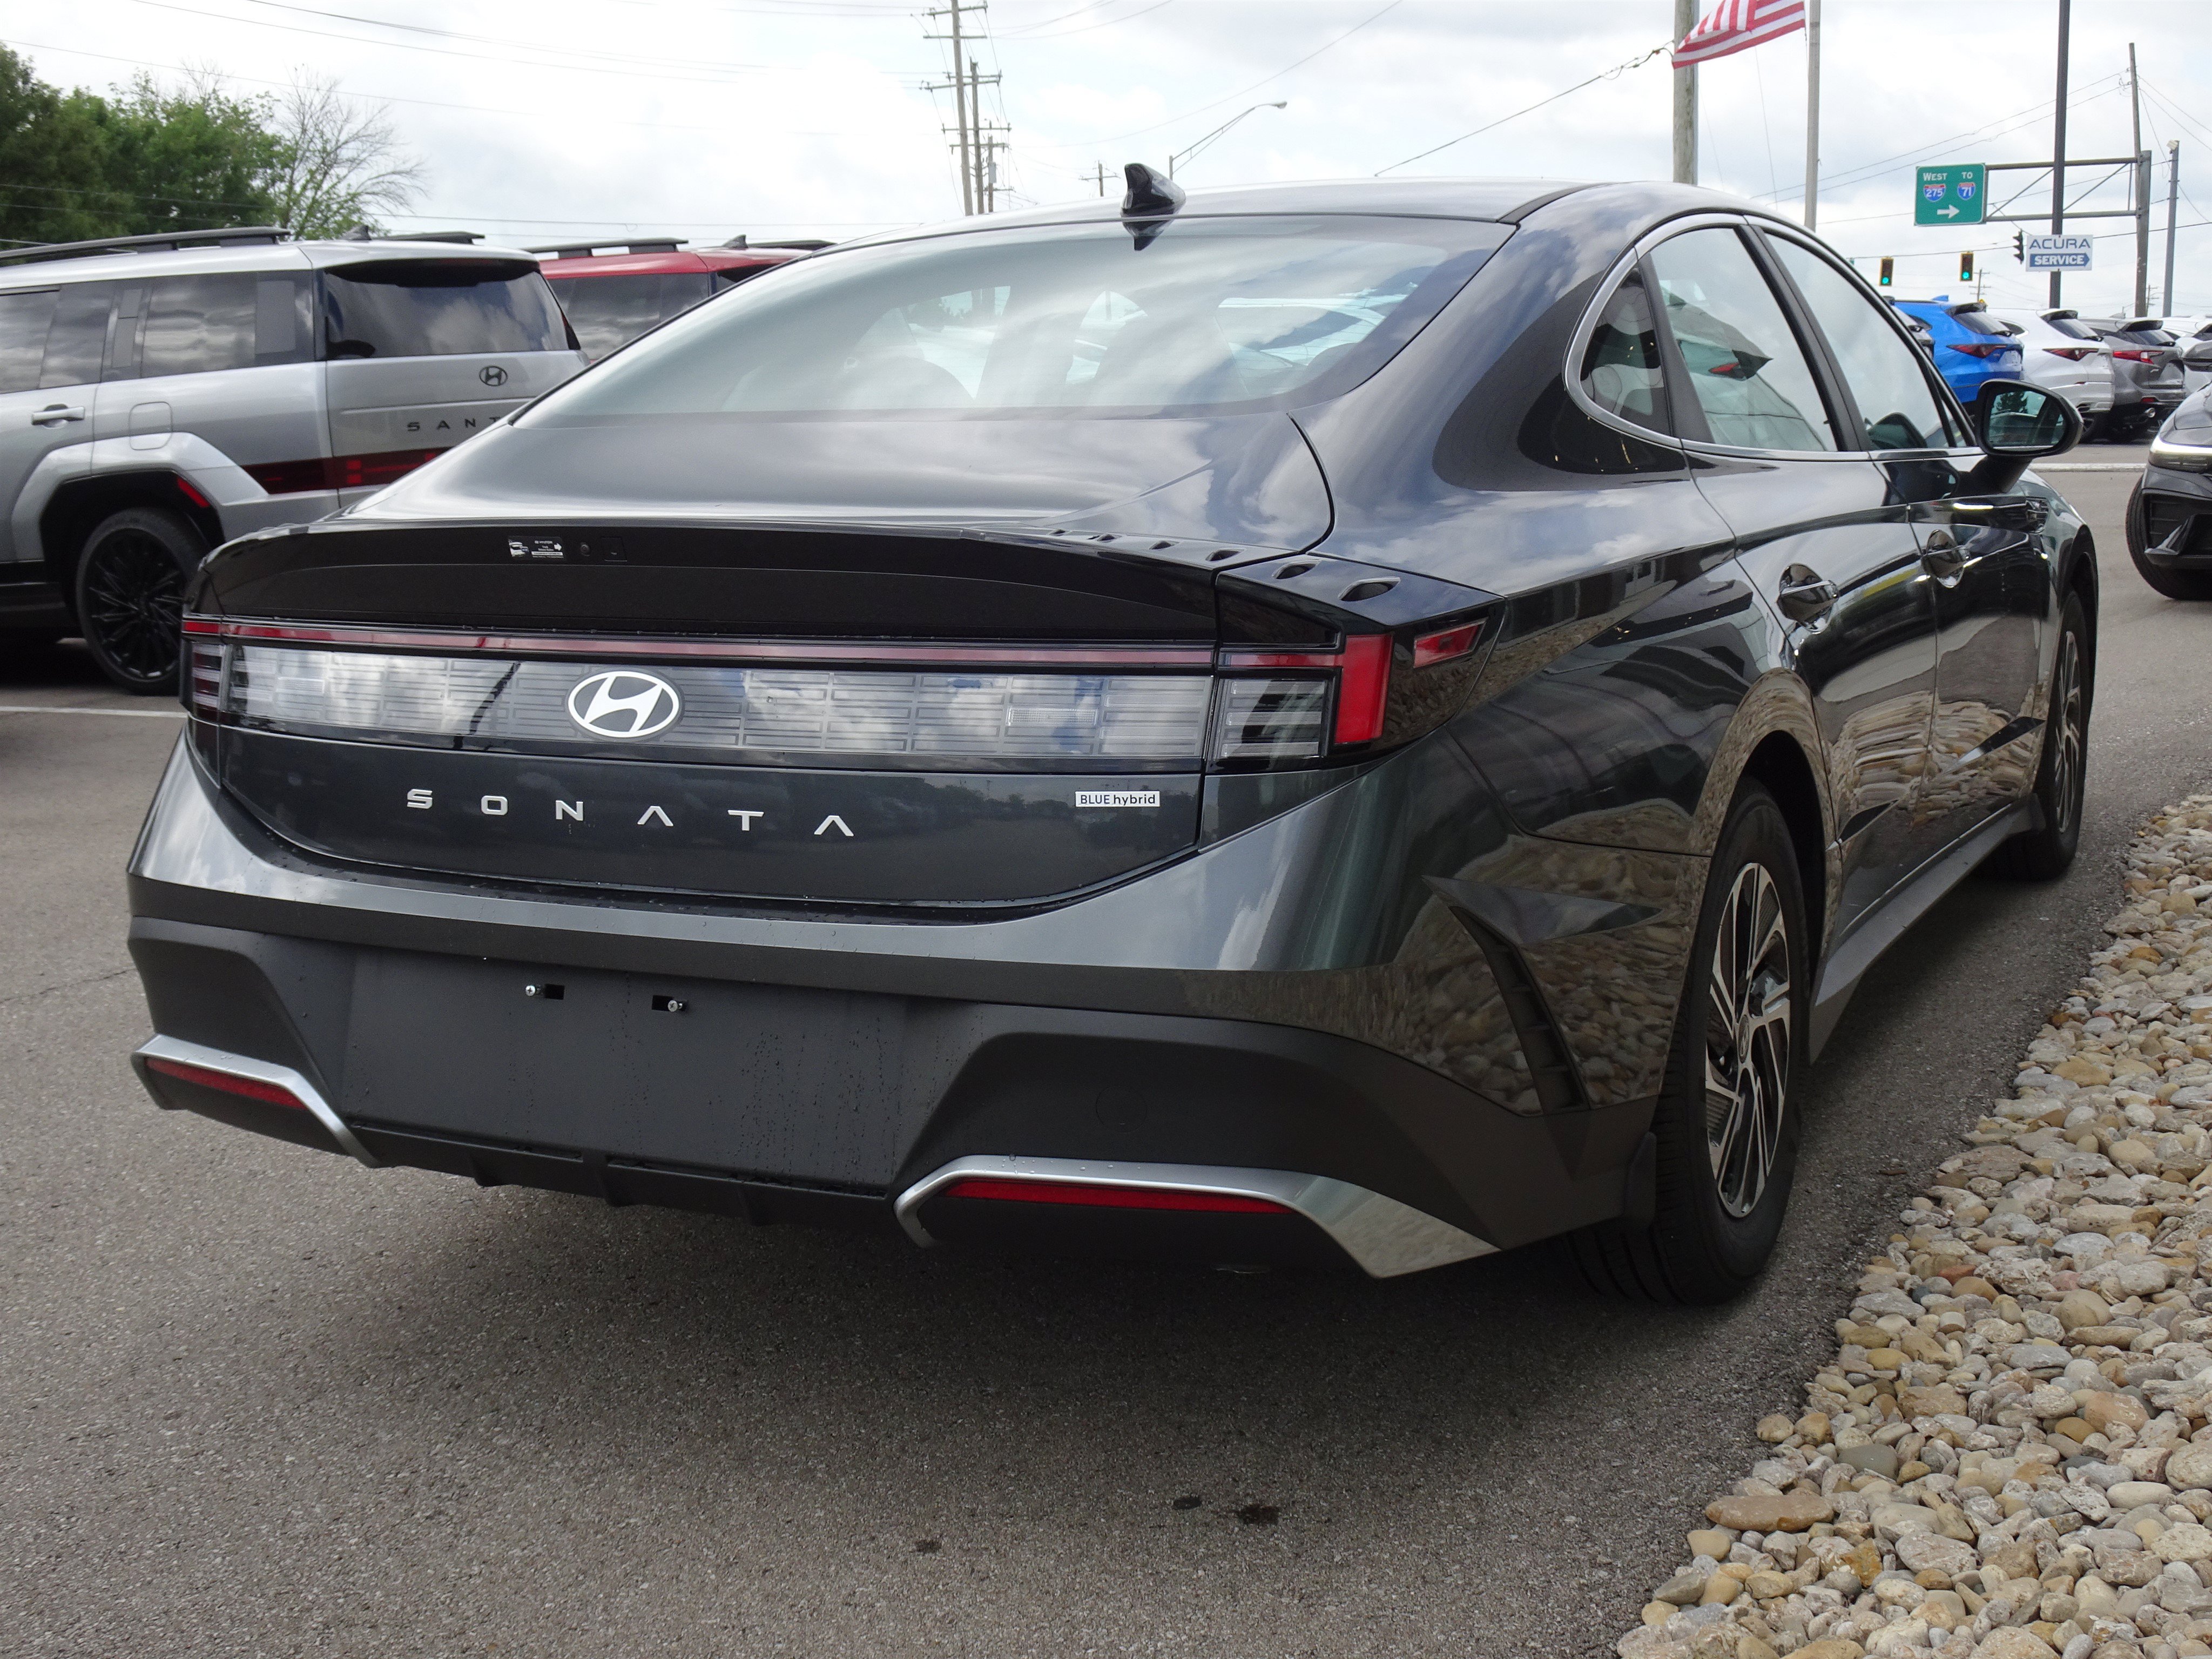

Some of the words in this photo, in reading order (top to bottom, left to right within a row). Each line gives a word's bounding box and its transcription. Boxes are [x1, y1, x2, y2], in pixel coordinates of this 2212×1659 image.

[1923, 172, 1947, 181] WEST
[1926, 188, 1943, 197] 275
[1961, 187, 1972, 197] 71
[2029, 238, 2090, 249] ACURA
[2034, 255, 2085, 265] SERVICE
[1081, 794, 1110, 804] BLUE
[1114, 794, 1155, 805] hybrid
[407, 788, 854, 837] SONATA
